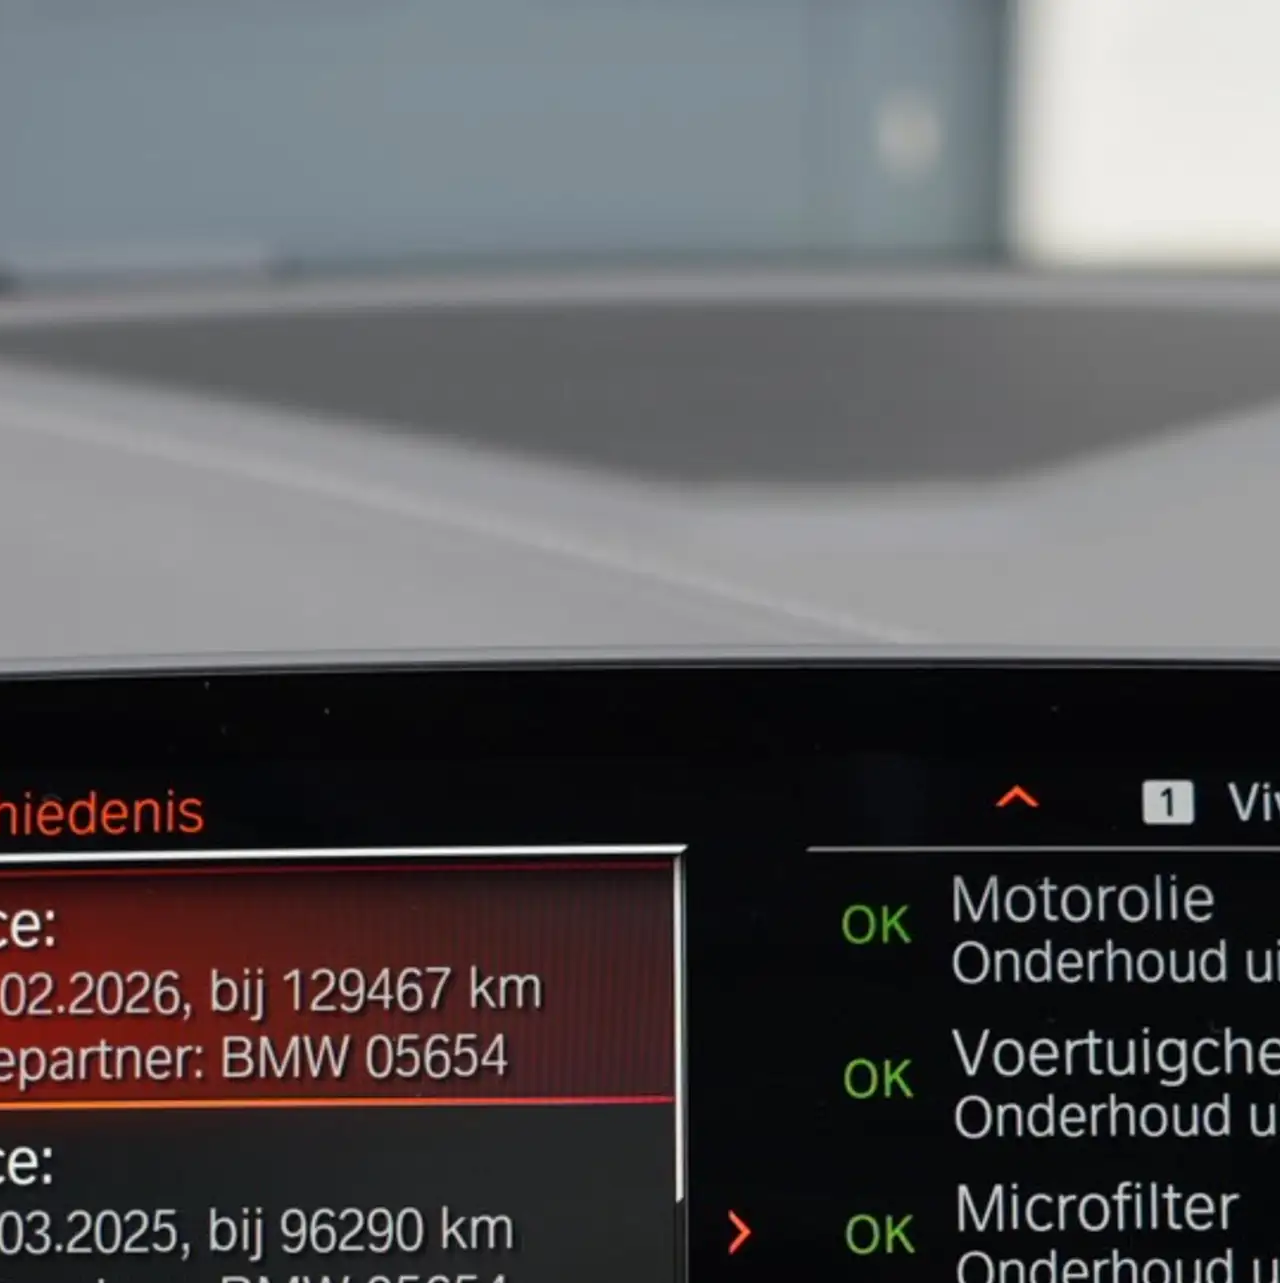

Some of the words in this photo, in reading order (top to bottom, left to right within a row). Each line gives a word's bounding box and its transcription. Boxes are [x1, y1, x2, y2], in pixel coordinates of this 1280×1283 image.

[952, 875, 1213, 922] Motorolie
[843, 906, 910, 943] OK
[953, 940, 1226, 984] Onderhoud
[212, 968, 263, 1021] bij
[284, 967, 451, 1012] 129467
[471, 966, 542, 1010] km
[223, 1035, 349, 1077] BMW
[366, 1034, 507, 1078] 05654
[845, 1059, 912, 1098] OK
[956, 1093, 1230, 1138] Onderhoud
[958, 1181, 1239, 1231] Microfilter
[210, 1207, 262, 1261] bij
[281, 1207, 423, 1253] 96290
[442, 1206, 512, 1249] km
[847, 1215, 914, 1254] OK
